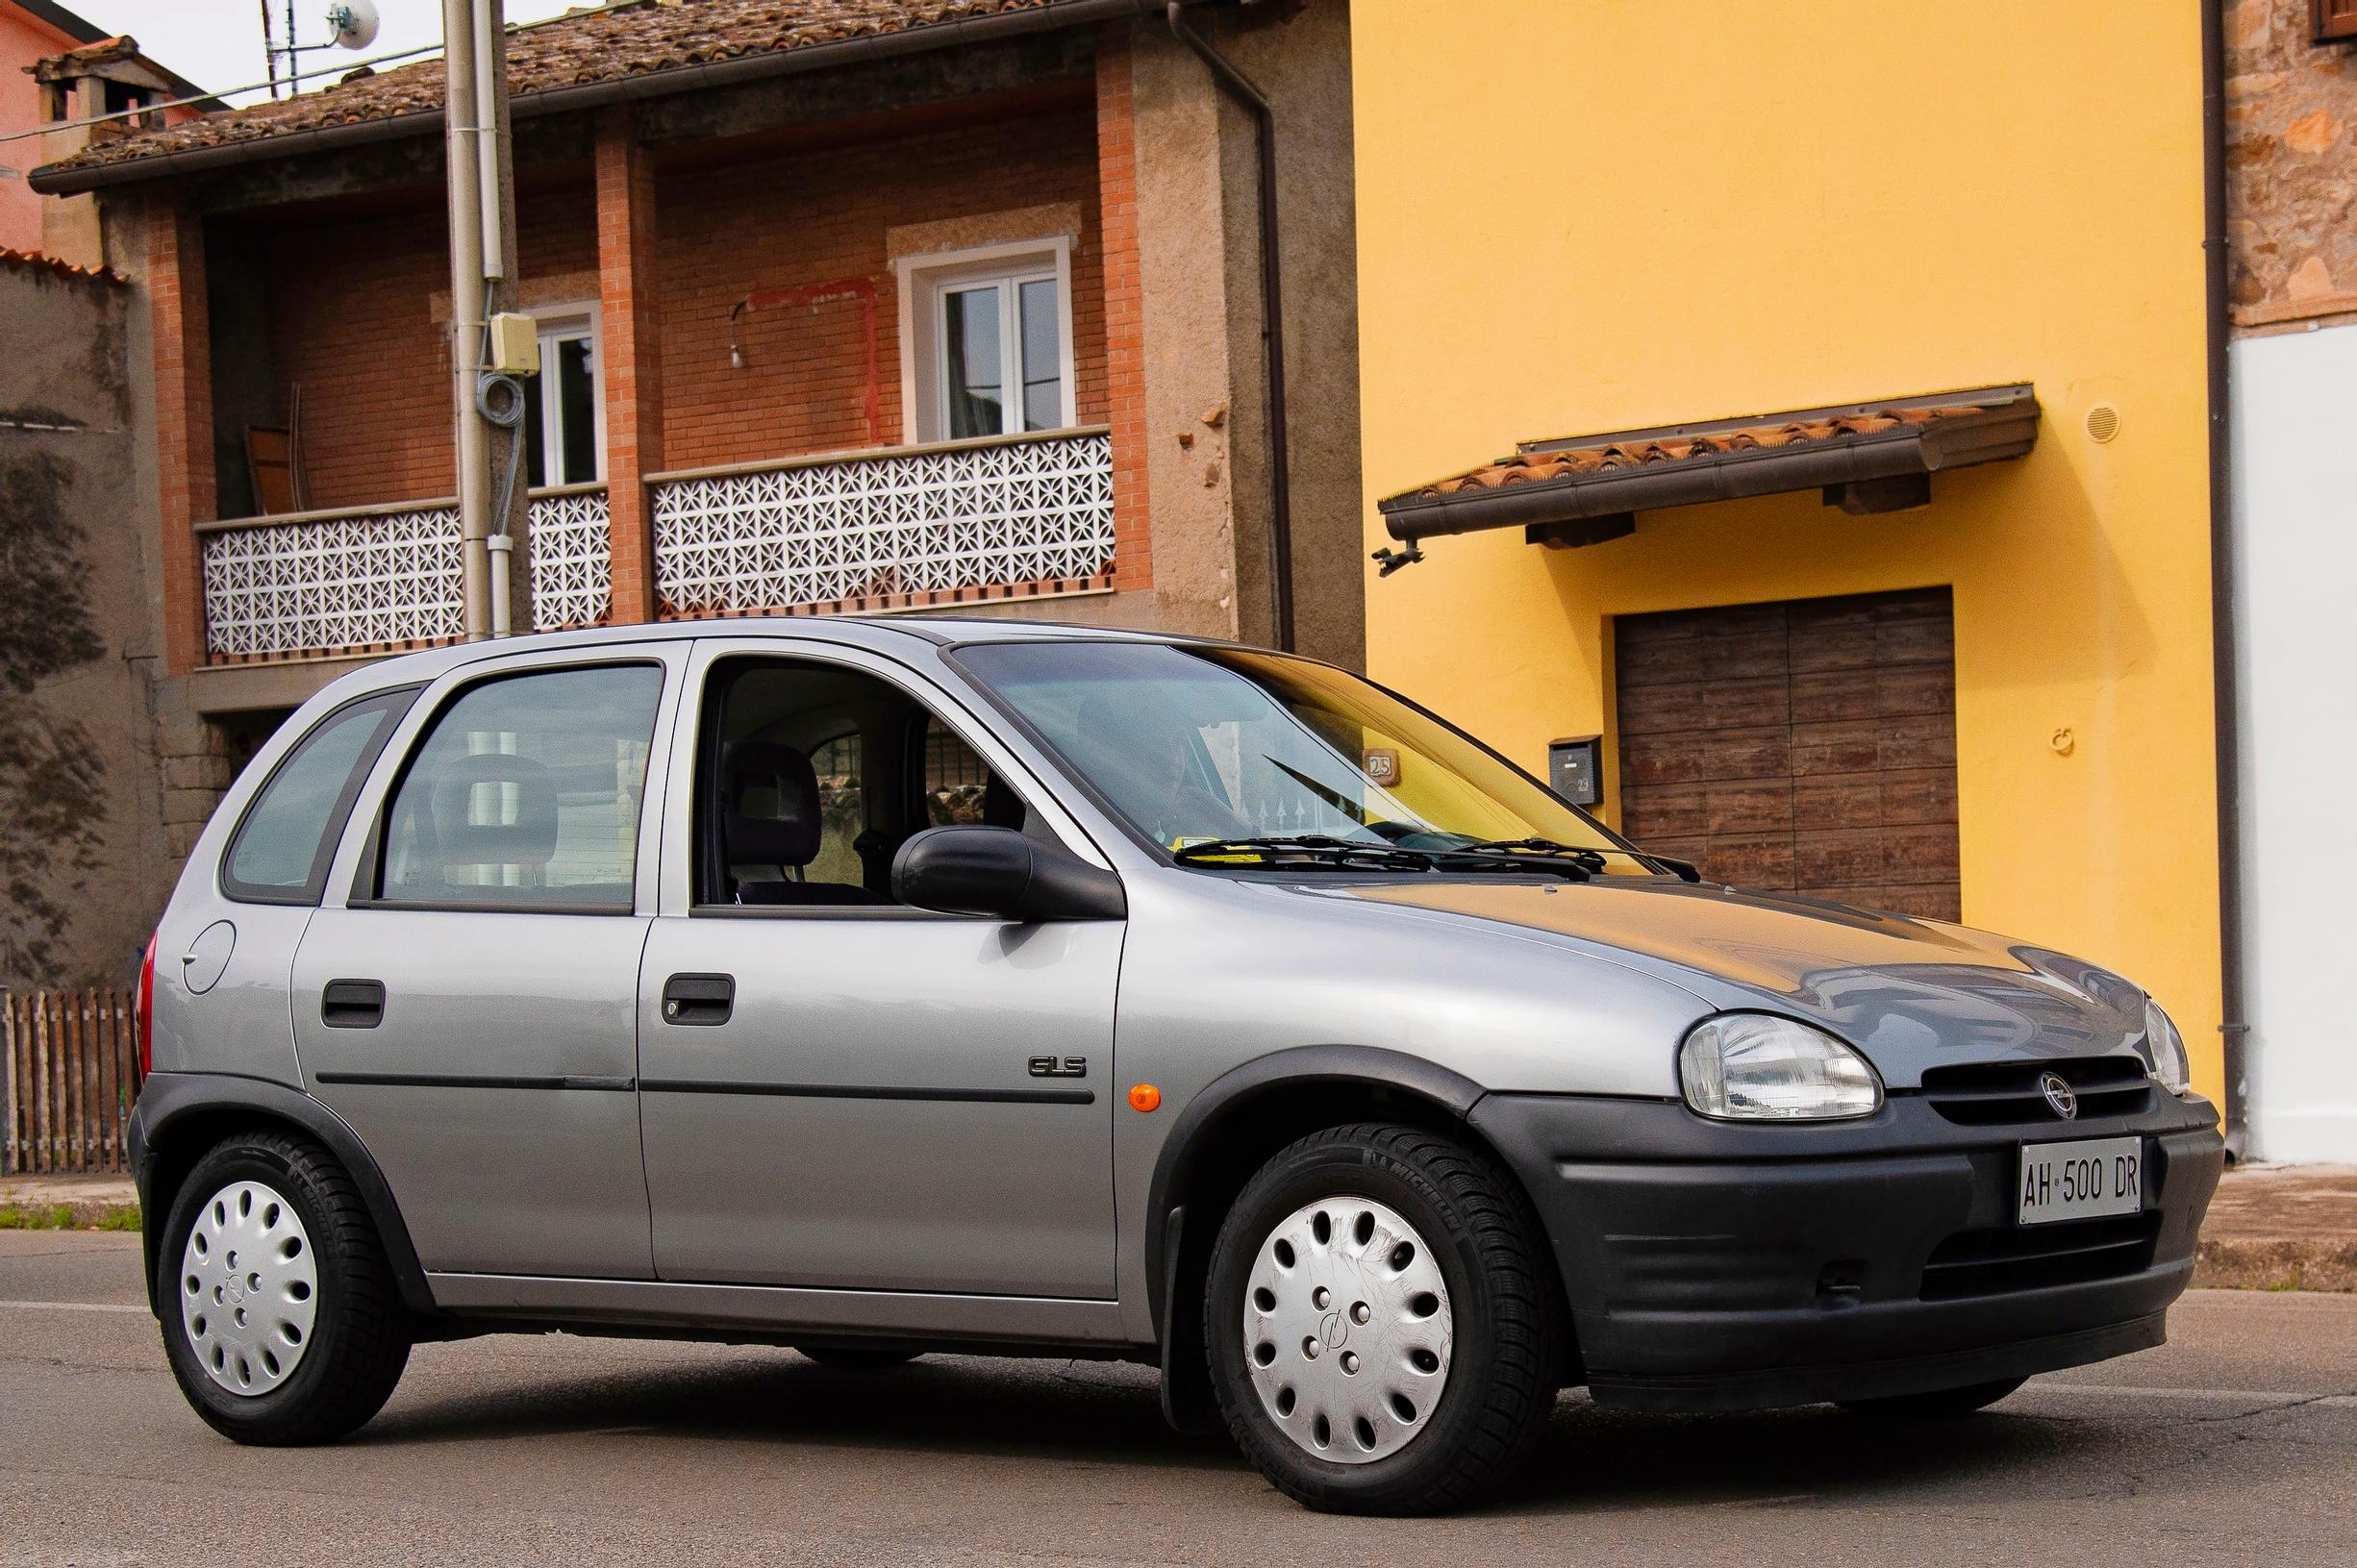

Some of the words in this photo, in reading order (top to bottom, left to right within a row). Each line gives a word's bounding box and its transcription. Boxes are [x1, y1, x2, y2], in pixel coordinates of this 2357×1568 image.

[1370, 758, 1390, 774] 25
[1577, 778, 1589, 792] 23
[1028, 1056, 1087, 1078] GLS
[2023, 1161, 2051, 1207] AH
[2063, 1157, 2102, 1202] 500
[2115, 1155, 2138, 1198] DR
[1389, 1160, 1463, 1231] MICHELIN
